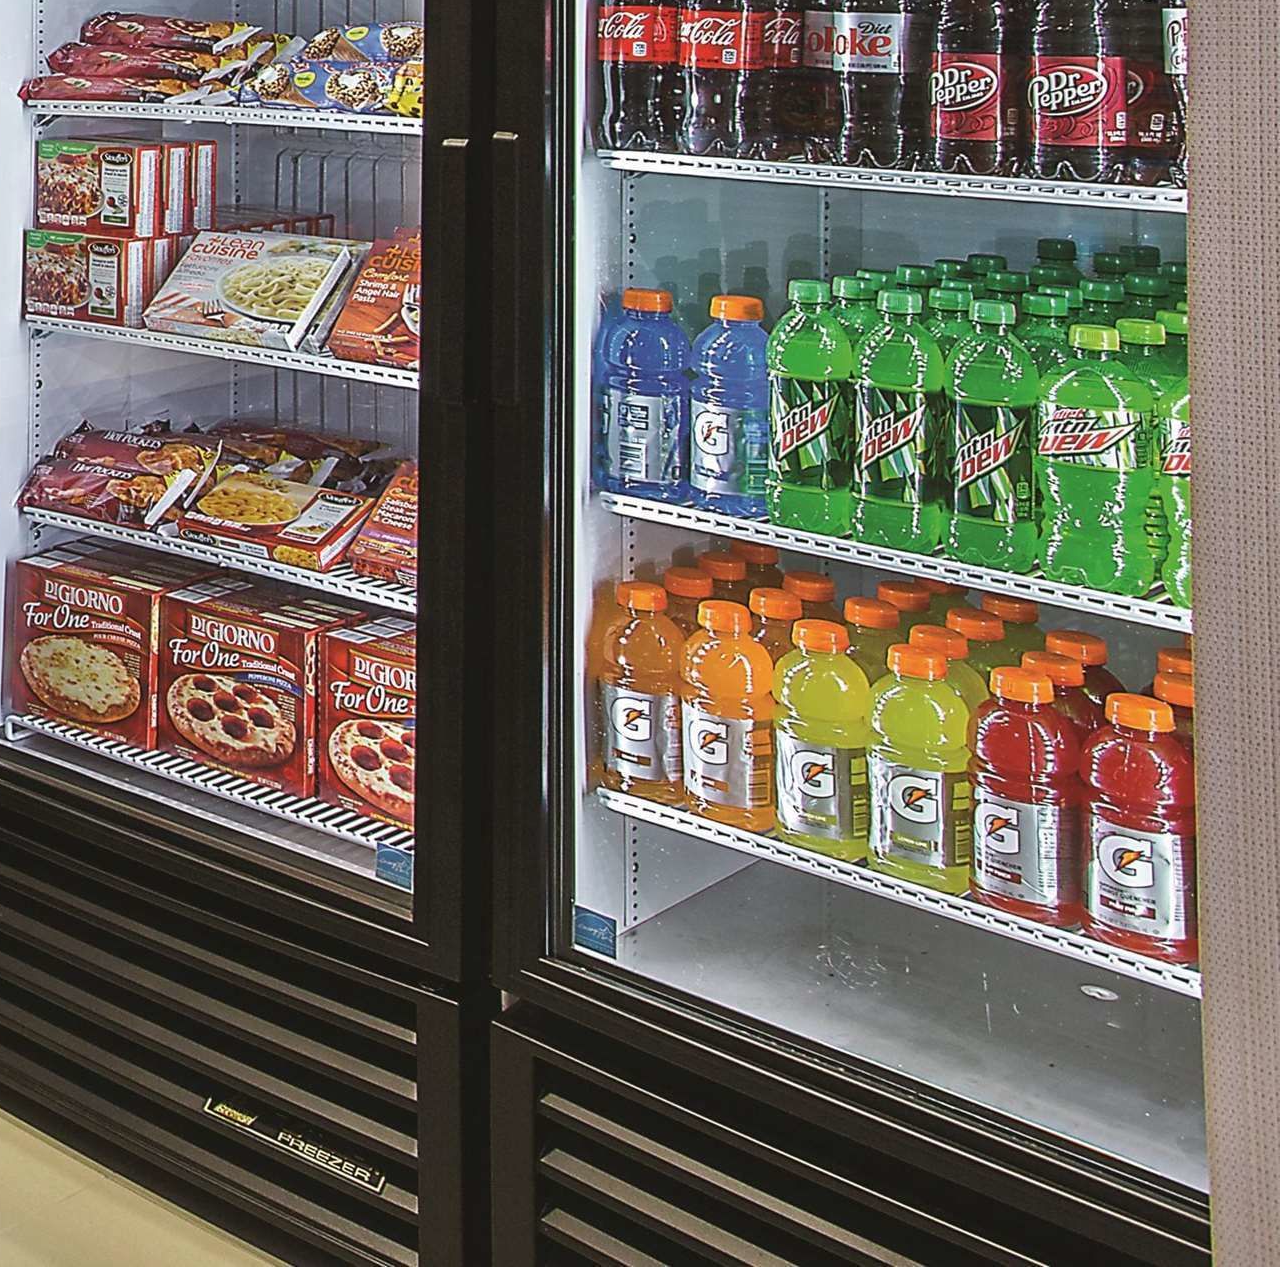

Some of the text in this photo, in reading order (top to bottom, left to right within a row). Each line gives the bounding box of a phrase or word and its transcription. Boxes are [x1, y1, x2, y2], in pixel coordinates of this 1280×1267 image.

[835, 28, 892, 57] oke
[857, 21, 892, 35] Diet
[931, 72, 991, 105] Pepper
[944, 67, 973, 87] Dr
[1031, 76, 1102, 110] Pepper
[1050, 71, 1081, 91] Dr
[370, 256, 420, 272] CUISI
[352, 293, 376, 304] Pasta
[355, 287, 400, 299] Angel Hair
[360, 279, 390, 291] Shrimp
[694, 410, 730, 456] G
[385, 496, 417, 511] Salisbu
[381, 517, 413, 531] Cheese
[44, 579, 123, 615] DIGIORNO
[23, 602, 52, 627] For
[53, 603, 90, 629] One
[91, 620, 125, 633] Traditional
[191, 614, 275, 655] DIGIORNO
[169, 638, 201, 666] For
[201, 641, 240, 668] One
[241, 659, 277, 673] Traditional
[354, 655, 416, 692] DIGIOR
[331, 681, 408, 714] For One
[611, 696, 653, 742] G
[689, 718, 729, 766] G
[791, 749, 836, 799] G
[888, 773, 939, 825] G
[974, 801, 1020, 855] G
[1098, 834, 1155, 888] G
[277, 1131, 372, 1182] FREEZER
